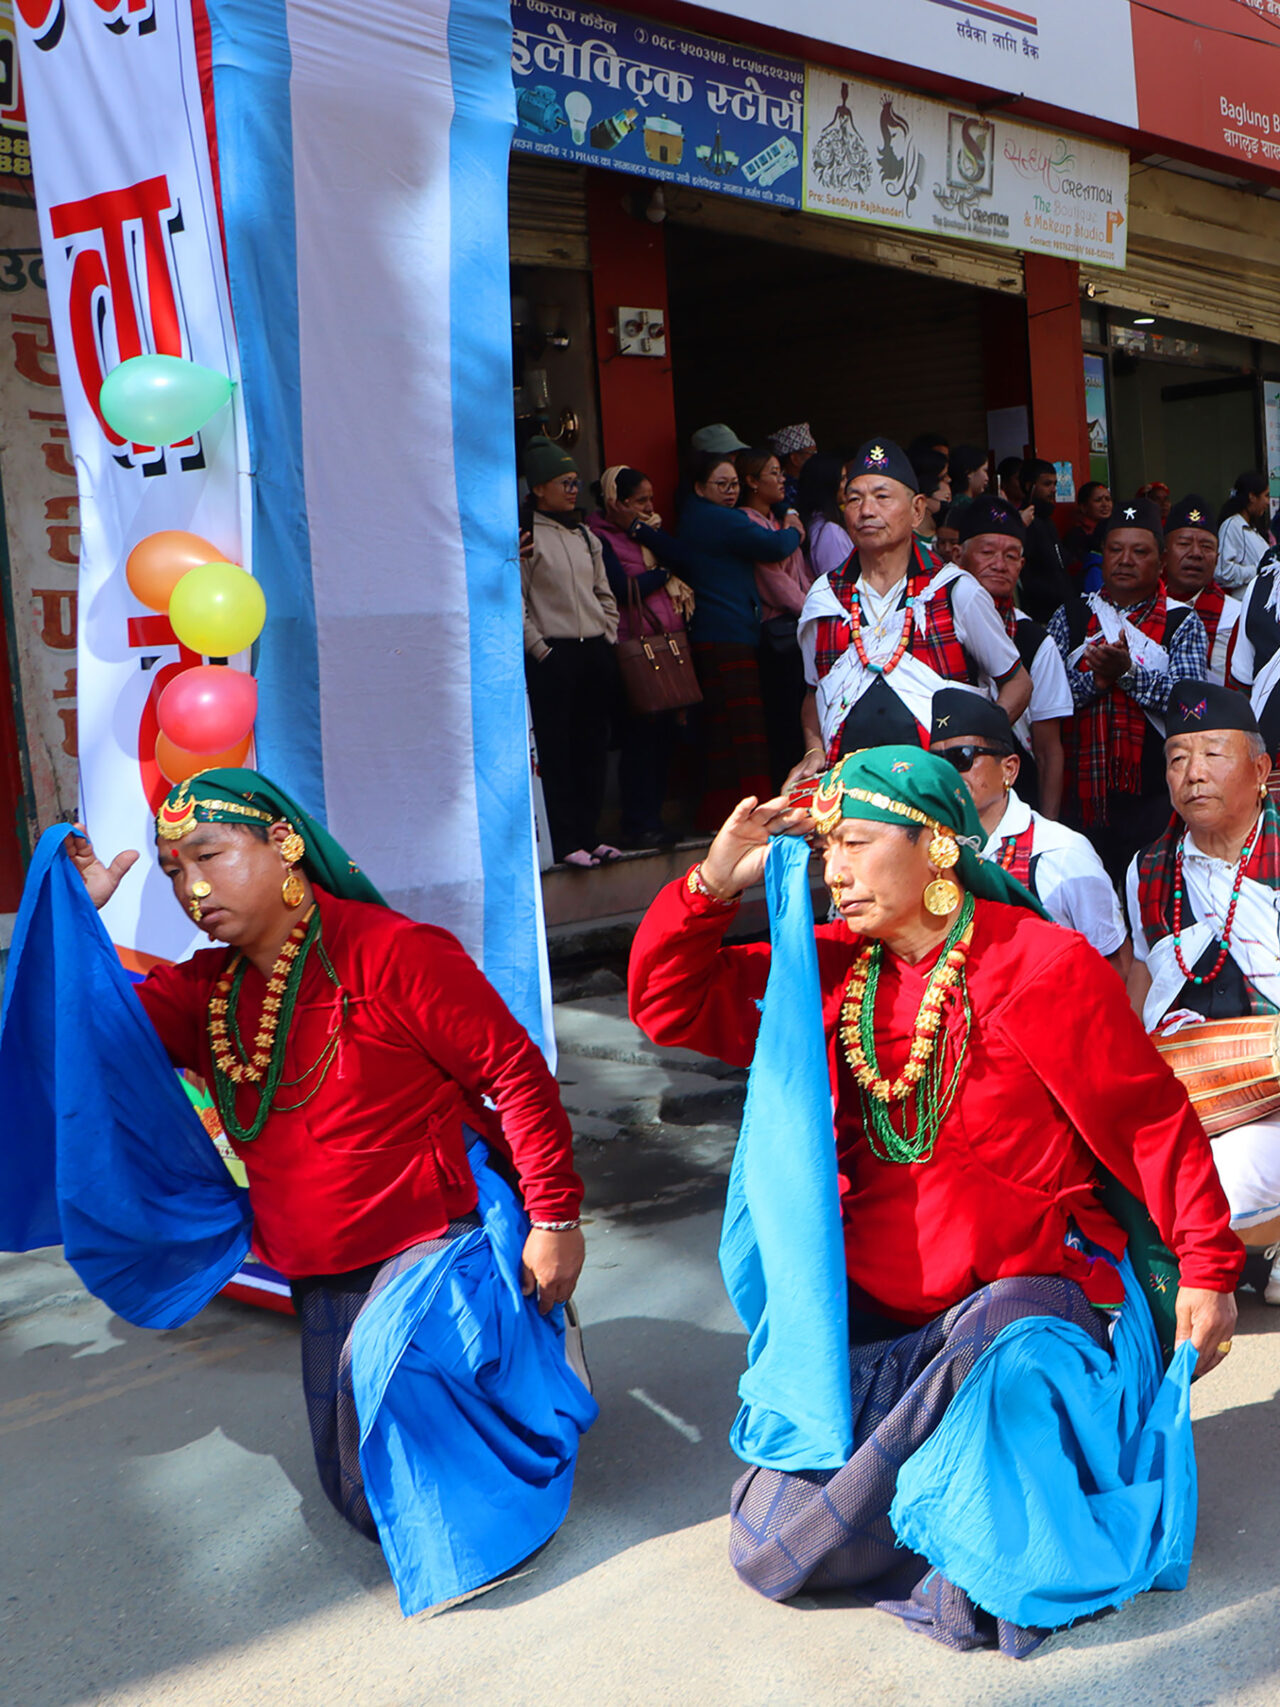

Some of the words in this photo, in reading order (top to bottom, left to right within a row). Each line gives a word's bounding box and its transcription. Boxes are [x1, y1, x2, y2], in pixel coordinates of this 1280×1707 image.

[1220, 96, 1270, 134] Baglung
[826, 192, 859, 211] Sandhya
[1033, 194, 1052, 213] The
[1034, 214, 1072, 237] Makeup
[1074, 222, 1105, 241] Studio
